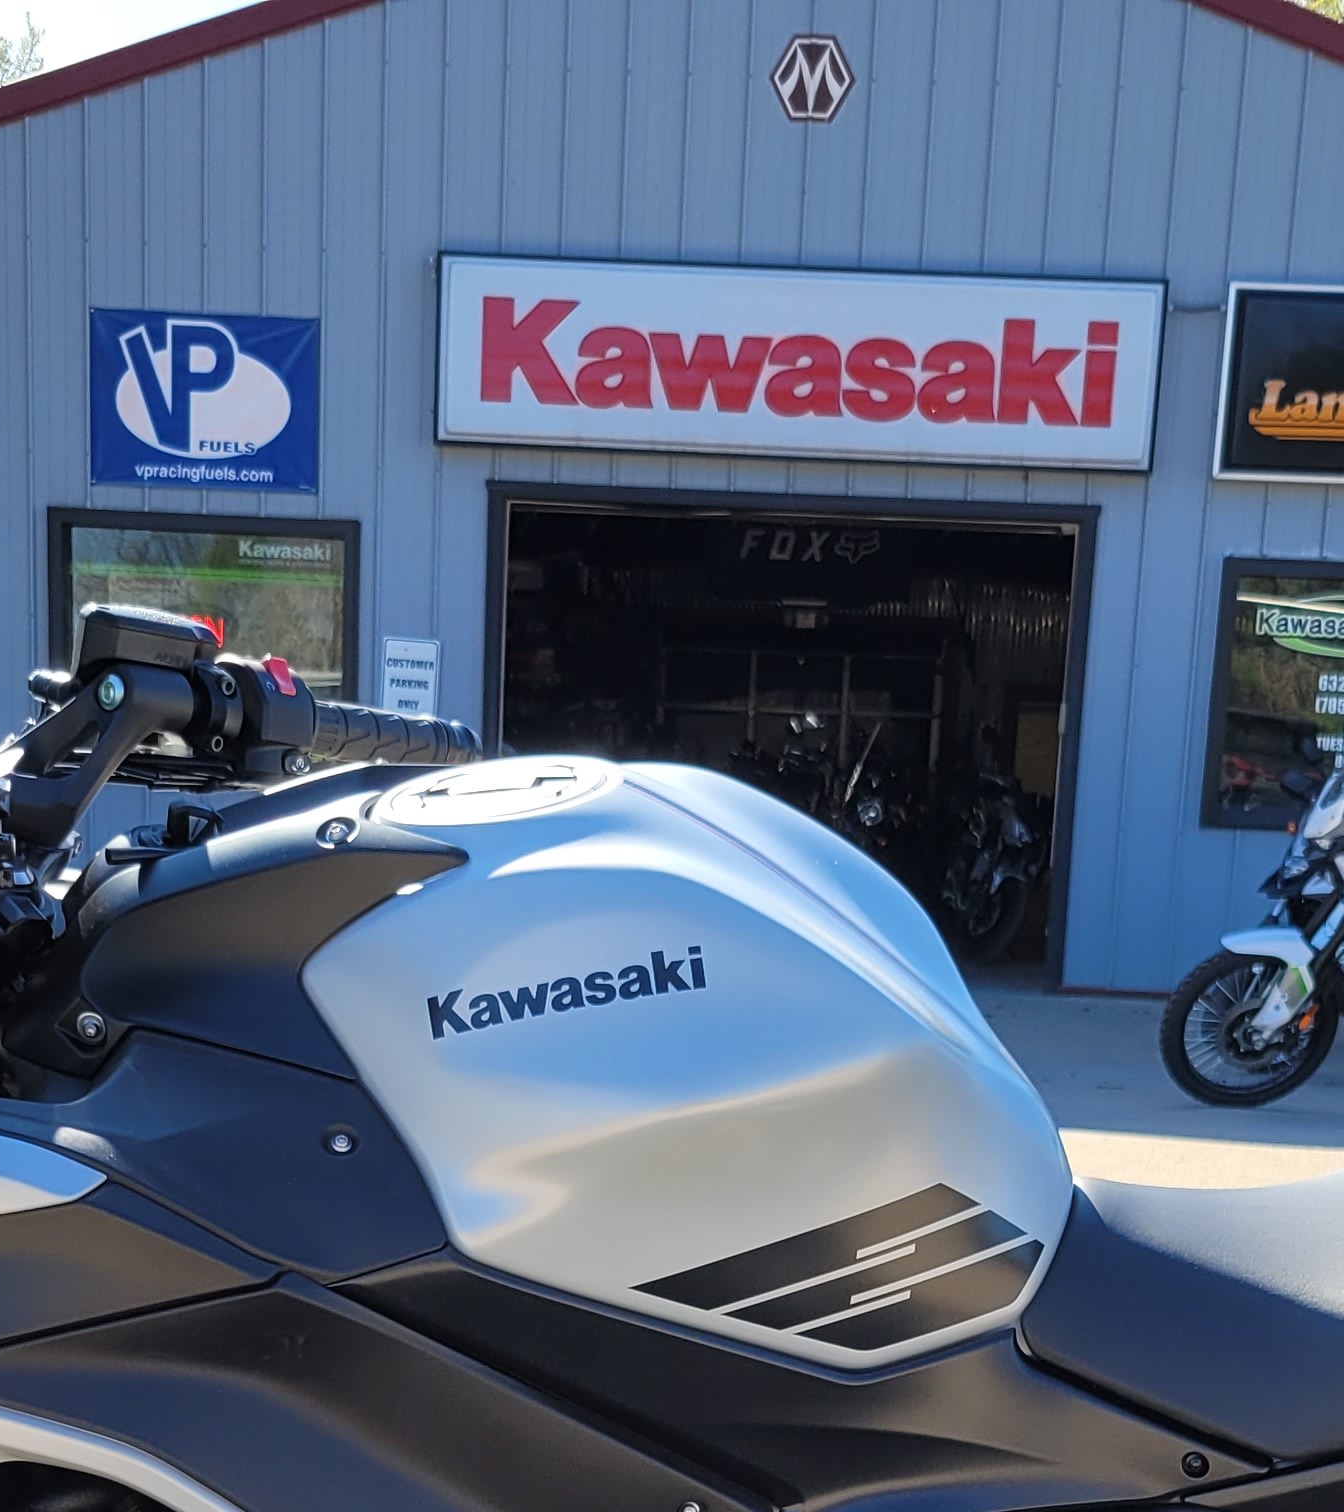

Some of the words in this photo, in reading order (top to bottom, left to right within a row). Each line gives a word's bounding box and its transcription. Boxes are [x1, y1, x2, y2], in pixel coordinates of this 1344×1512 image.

[480, 295, 1120, 429] Kawasaki
[119, 318, 239, 456] VP
[198, 440, 257, 456] FUELS
[134, 463, 274, 484] vpracingfuels.com
[239, 539, 332, 562] Kawasaki
[739, 528, 832, 562] FOX
[386, 658, 435, 671] CUSTOMER
[389, 678, 430, 690] PARKING
[397, 699, 420, 710] ONLY
[425, 945, 706, 1041] Kawasaki
